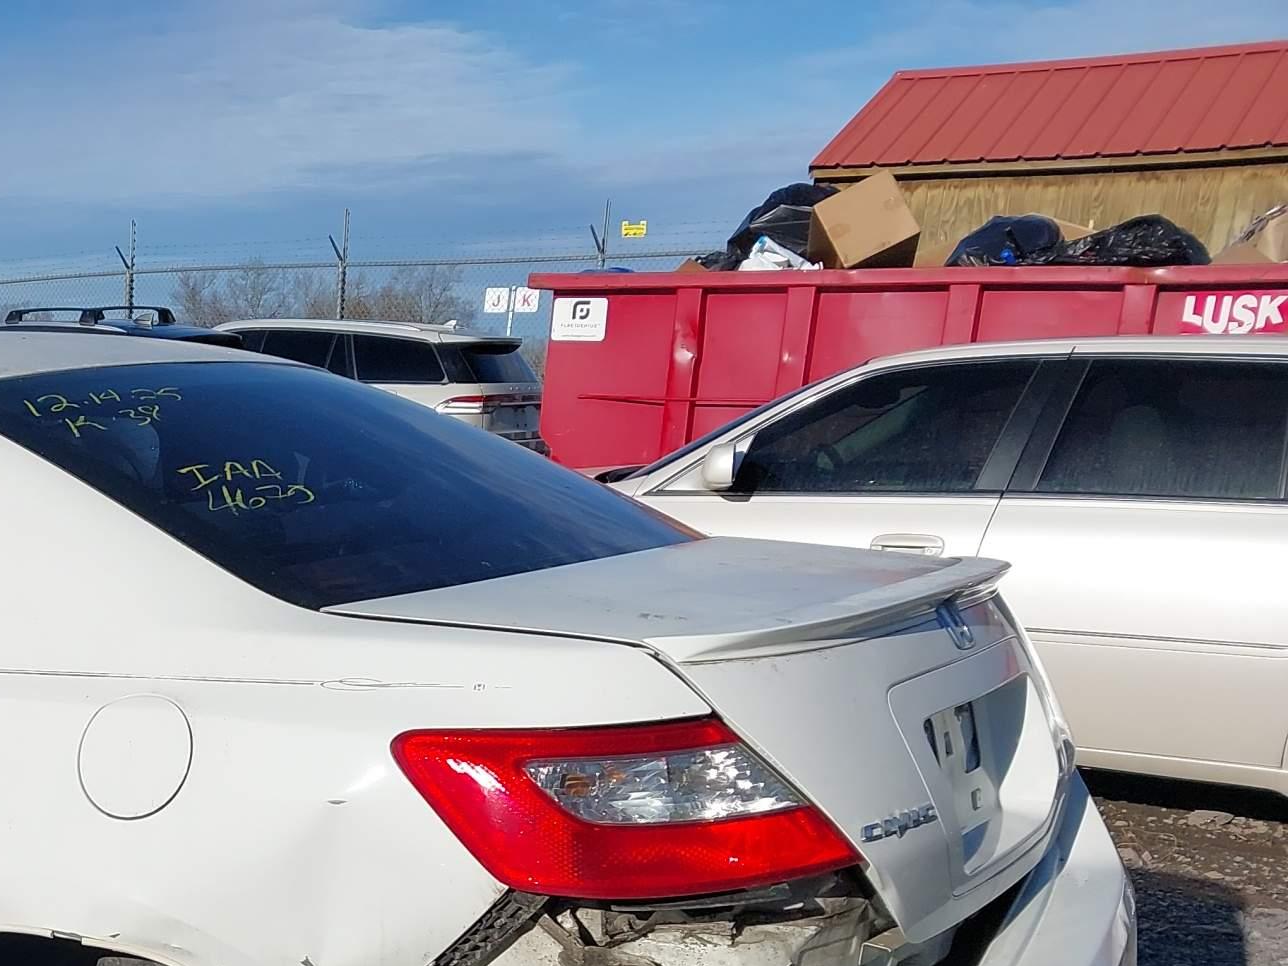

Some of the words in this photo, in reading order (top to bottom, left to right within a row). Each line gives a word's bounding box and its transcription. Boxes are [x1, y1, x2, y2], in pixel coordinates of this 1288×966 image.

[492, 294, 501, 307] J
[522, 294, 532, 307] K
[1182, 294, 1288, 334] LUSK
[176, 459, 283, 490] IAA
